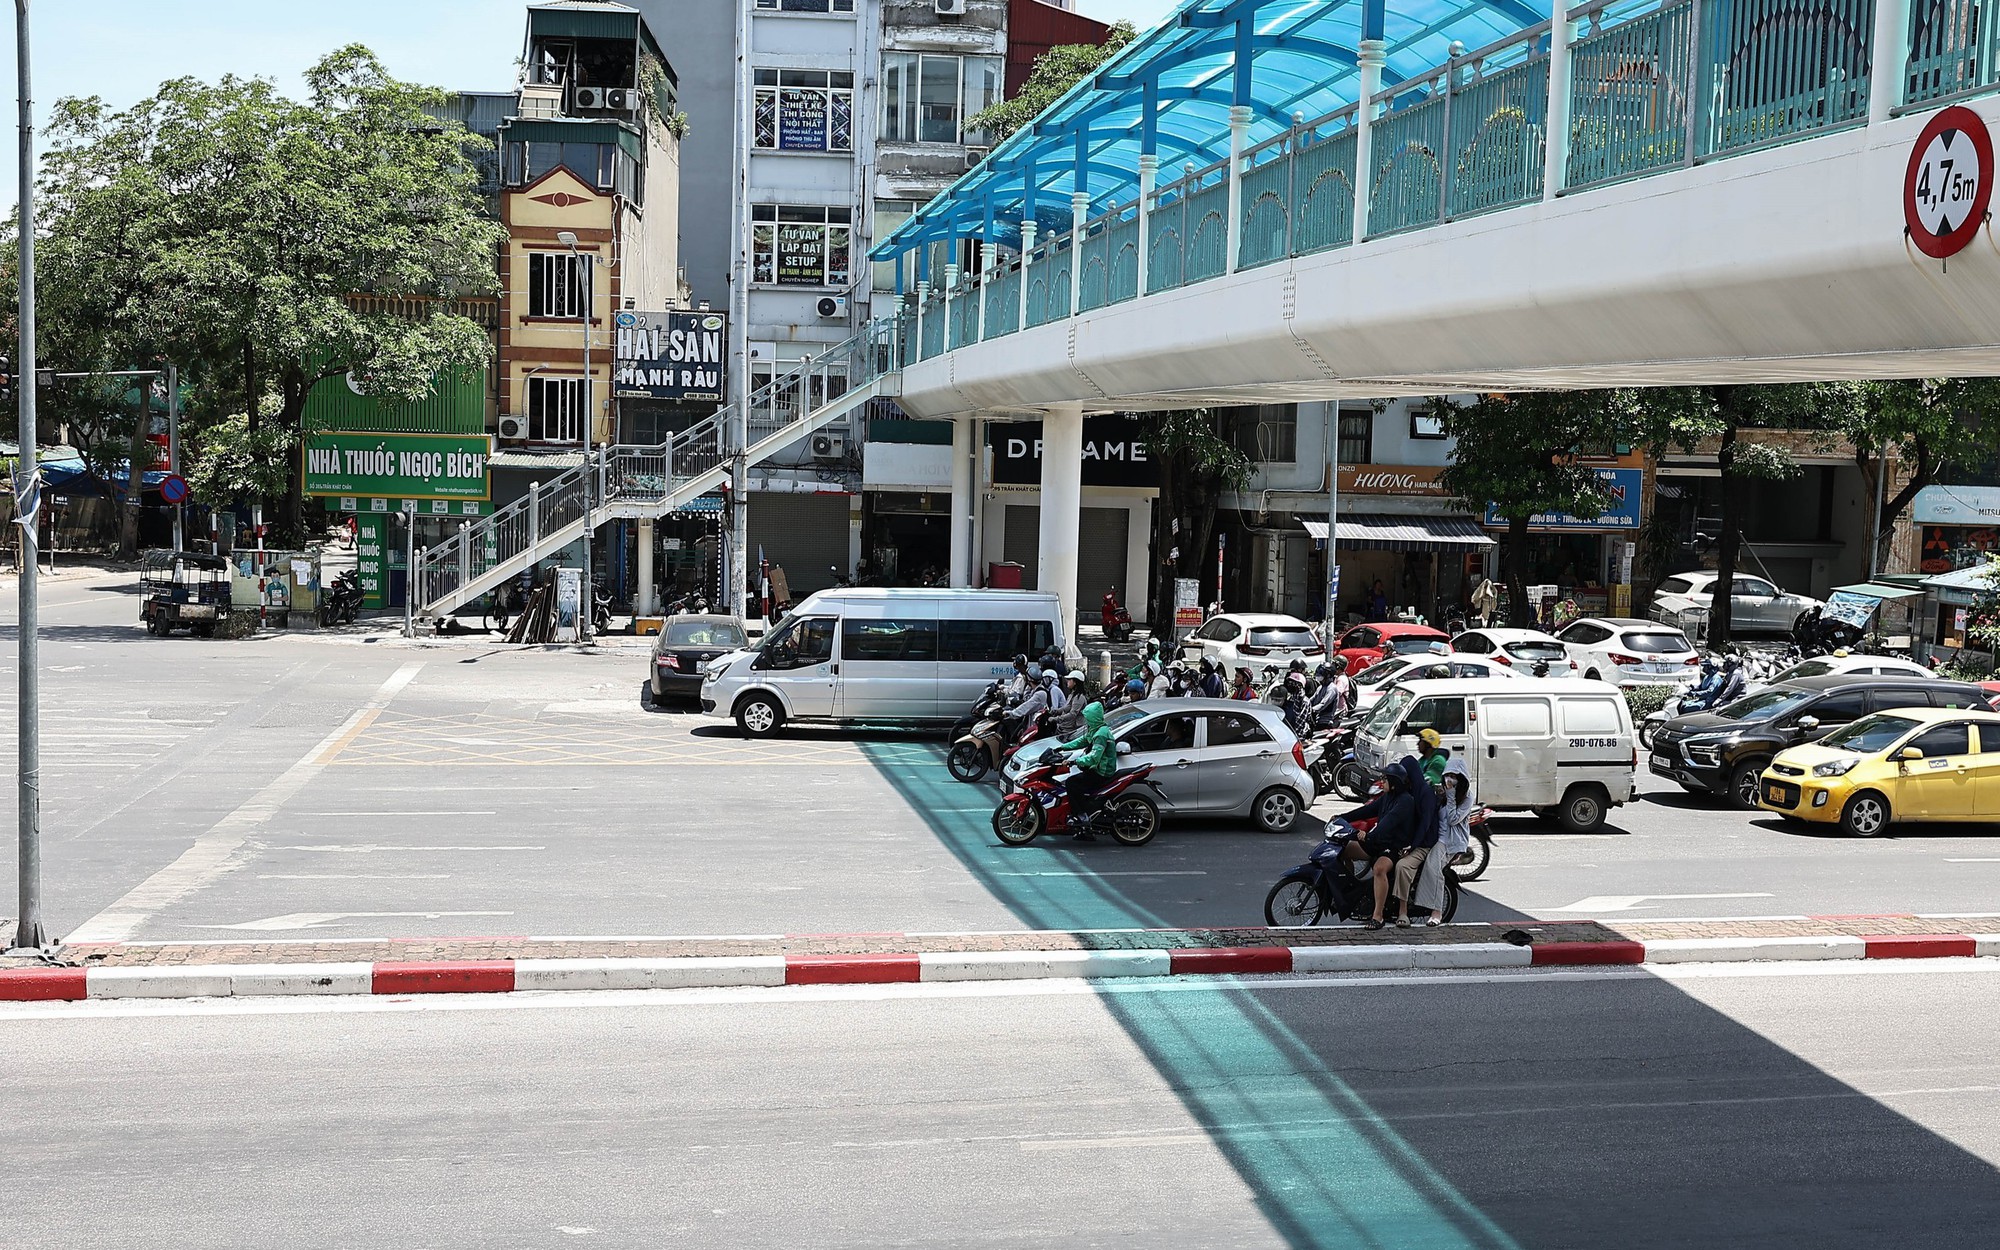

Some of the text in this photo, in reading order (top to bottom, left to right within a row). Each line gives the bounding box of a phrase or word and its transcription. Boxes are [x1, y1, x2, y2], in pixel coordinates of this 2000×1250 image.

[800, 109, 823, 118] CÔNG
[786, 119, 800, 128] NỘI
[1917, 159, 1974, 212] 4,75m
[784, 227, 818, 240] TƯ VẤN
[802, 242, 821, 255] ĐẶT
[785, 256, 816, 266] SETUP
[617, 316, 719, 363] HẢI SẢN
[621, 366, 717, 389] MẠNH RÂU
[308, 444, 341, 474] NHÀ
[345, 442, 395, 476] THUỐC
[400, 452, 442, 482] NGỌC
[1354, 472, 1416, 489] HƯƠNG
[1546, 515, 1556, 523] BIA
[362, 525, 376, 539] NHÀ
[359, 543, 380, 557] THUỐC
[360, 561, 378, 575] NGỌC
[1569, 738, 1617, 747] 29D-076.86
